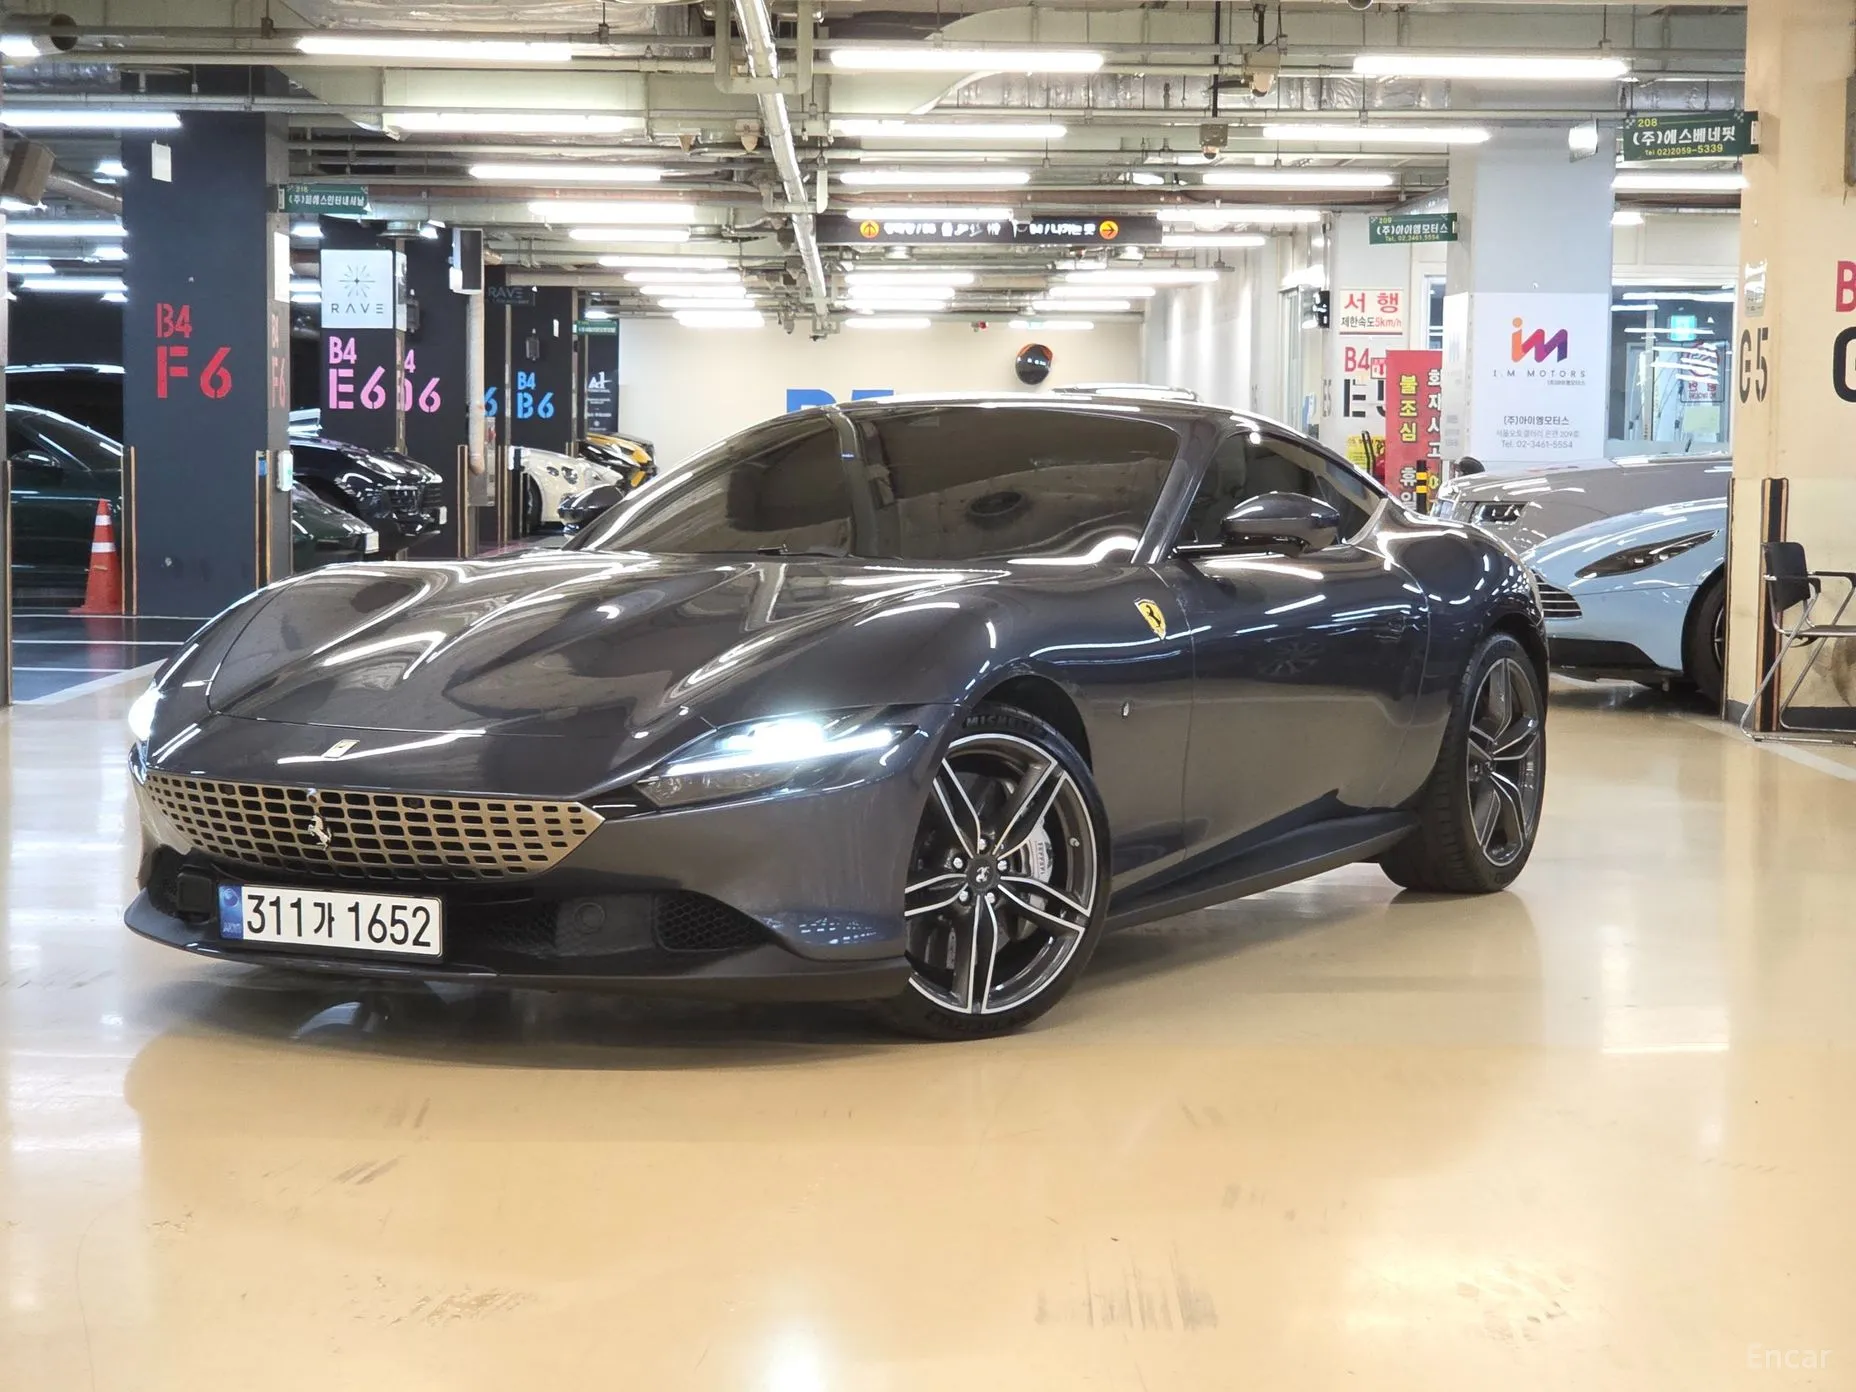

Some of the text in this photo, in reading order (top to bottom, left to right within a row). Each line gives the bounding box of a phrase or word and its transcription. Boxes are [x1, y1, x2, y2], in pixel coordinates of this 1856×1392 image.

[1632, 126, 1736, 146] (주)에스베네핏
[1637, 118, 1658, 128] 208
[1376, 223, 1449, 235] (주)아이엠모터스
[156, 302, 193, 339] B4
[328, 336, 357, 365] B4
[1344, 346, 1370, 373] B4
[156, 346, 233, 399] F6
[517, 371, 537, 391] B4
[1527, 370, 1586, 378] MOTORS
[328, 366, 387, 410] E6
[516, 392, 555, 419] B6
[1503, 415, 1570, 426] (주)아이엠모터스
[246, 894, 432, 948] 311가 1652
